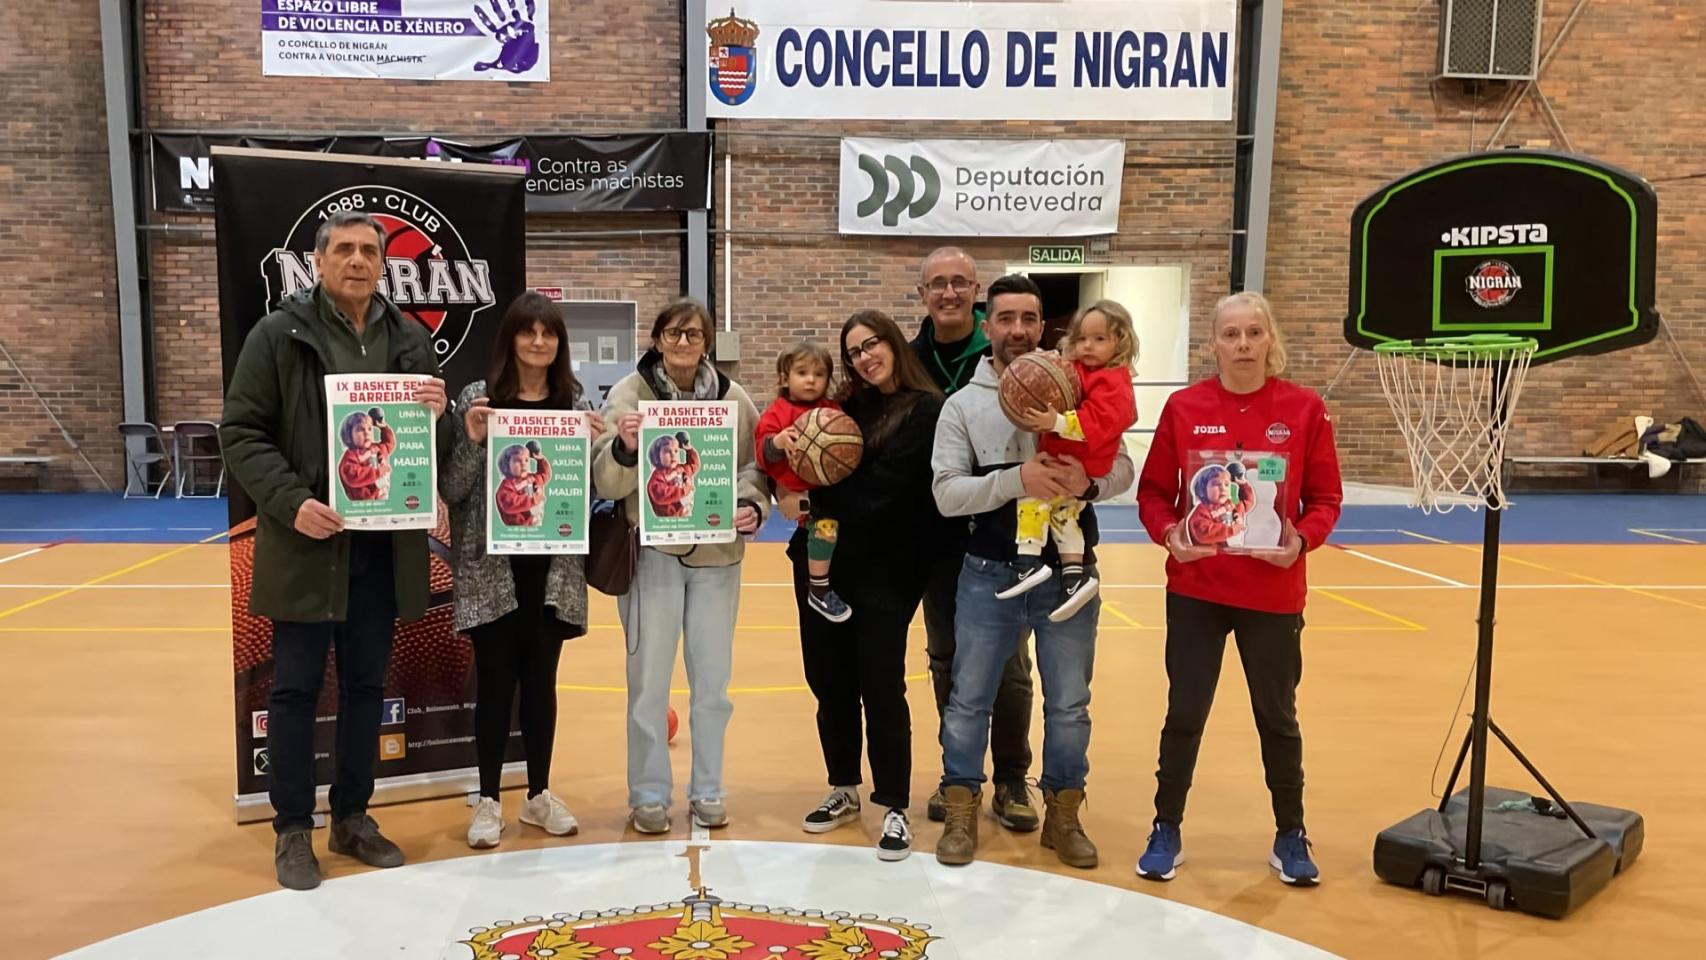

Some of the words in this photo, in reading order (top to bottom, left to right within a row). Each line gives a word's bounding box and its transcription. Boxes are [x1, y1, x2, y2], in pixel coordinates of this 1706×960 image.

[278, 0, 333, 13] ESPAZO
[337, 1, 378, 14] LIBRE
[278, 17, 297, 30] DE
[299, 17, 380, 32] VIOLENCIA
[383, 20, 402, 32] DE
[405, 18, 465, 34] XÉNERO
[278, 40, 286, 48] O
[288, 39, 337, 49] CONCELLO
[352, 40, 388, 50] NIGRÁN
[278, 51, 317, 61] CONTRA
[318, 52, 325, 61] A
[326, 53, 375, 63] VIOLENCIA
[376, 55, 424, 64] MACHISTA
[775, 27, 990, 90] CONCELLO
[1005, 31, 1057, 88] DE
[1073, 30, 1229, 89] NIGRAN
[537, 156, 601, 175] Contra
[607, 160, 628, 173] as
[525, 175, 585, 192] encias
[591, 172, 684, 190] machistas
[956, 163, 1105, 195] Deputación
[956, 192, 1103, 214] Pontevedra
[317, 193, 365, 222] 1988
[385, 194, 441, 233] CLUB
[1449, 223, 1548, 247] KIPSTA
[1030, 248, 1082, 262] SALIDA
[276, 244, 494, 305] NRÁN
[337, 382, 349, 391] IX
[354, 381, 399, 391] BASKET
[398, 410, 426, 418] UNHA
[648, 408, 659, 416] IX
[663, 407, 705, 416] BASKET
[708, 407, 729, 416] SEN
[498, 416, 509, 425] IX
[514, 416, 557, 425] BASKET
[560, 417, 582, 426] SEN
[659, 417, 723, 426] BARREIRAS
[395, 426, 429, 434] AXUDA
[509, 426, 576, 436] BARREIRAS
[703, 434, 729, 442] UNHA
[399, 442, 425, 450] PARA
[555, 444, 582, 452] UNHA
[700, 449, 731, 457] AXUDA
[393, 457, 429, 467] MAURI
[551, 459, 583, 467] AXUDA
[703, 463, 726, 471] PARA
[555, 473, 579, 481] PARA
[698, 477, 730, 486] MAURI
[549, 487, 582, 497] MAURI
